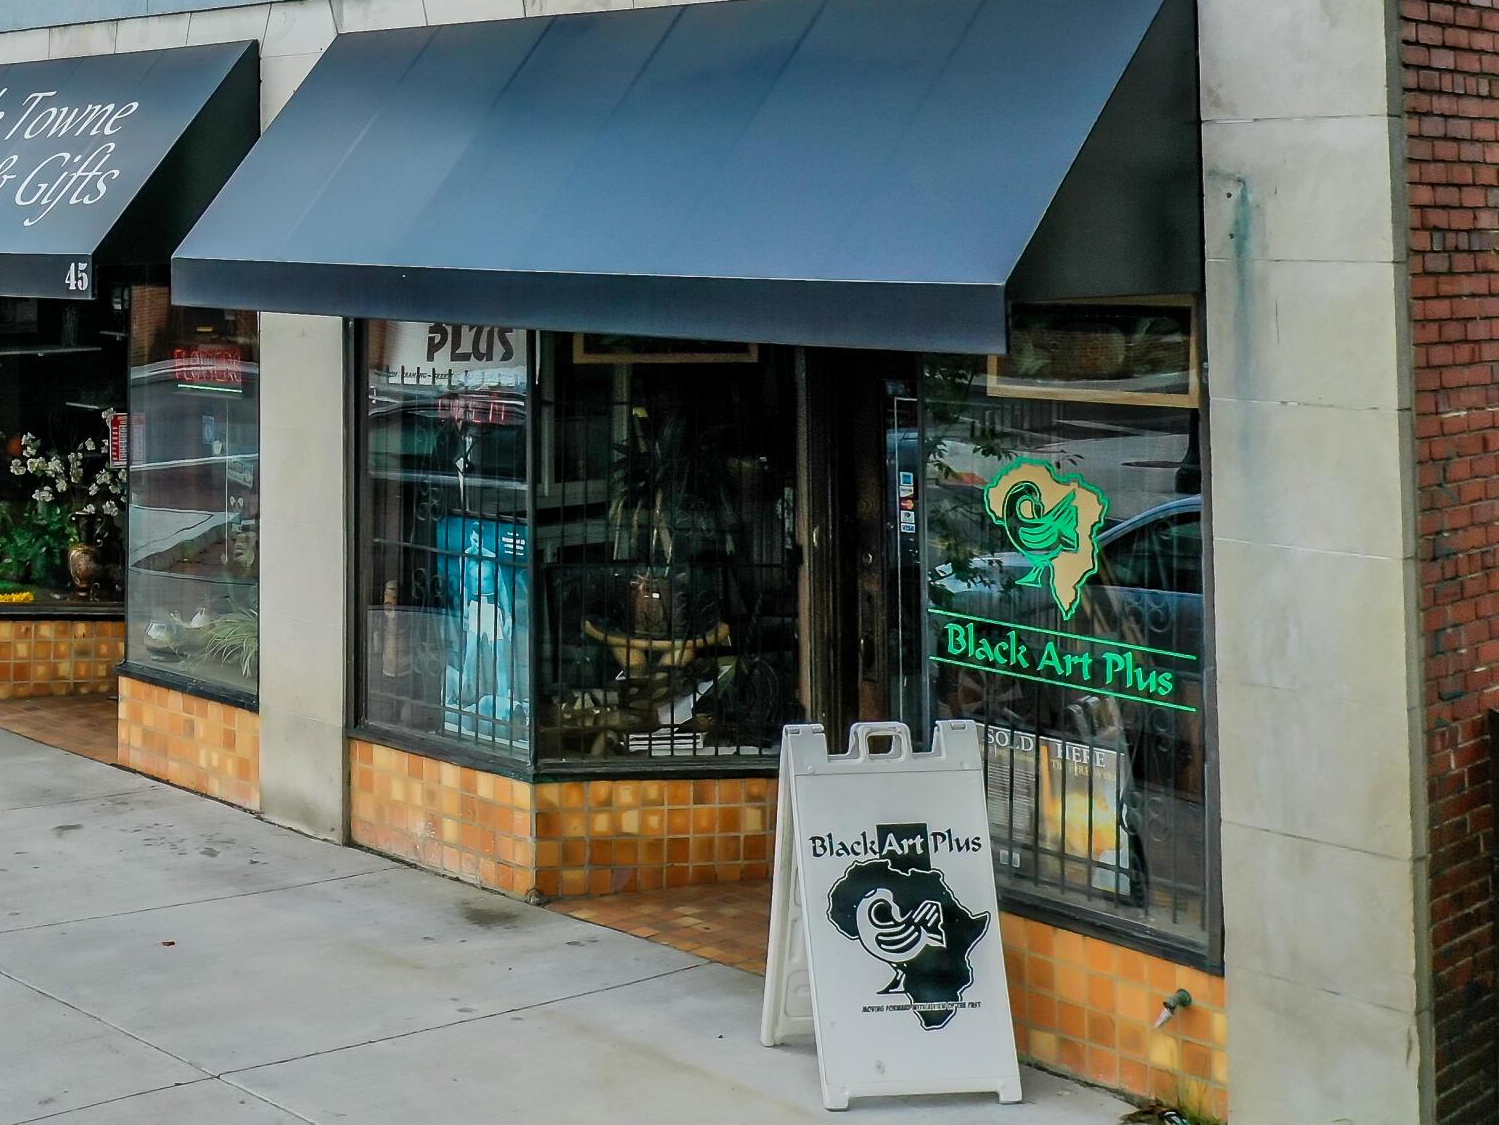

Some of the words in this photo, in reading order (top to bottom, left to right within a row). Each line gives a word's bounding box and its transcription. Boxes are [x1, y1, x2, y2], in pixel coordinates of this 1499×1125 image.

[4, 90, 139, 141] Towne
[14, 142, 120, 227] Gifts
[65, 262, 89, 291] 45
[426, 324, 514, 363] PLUS
[944, 622, 1030, 669] Black
[1036, 641, 1093, 681] Art
[1101, 651, 1174, 696] Plus
[809, 831, 880, 858] Black
[881, 832, 925, 856] Art
[930, 828, 982, 854] Plus
